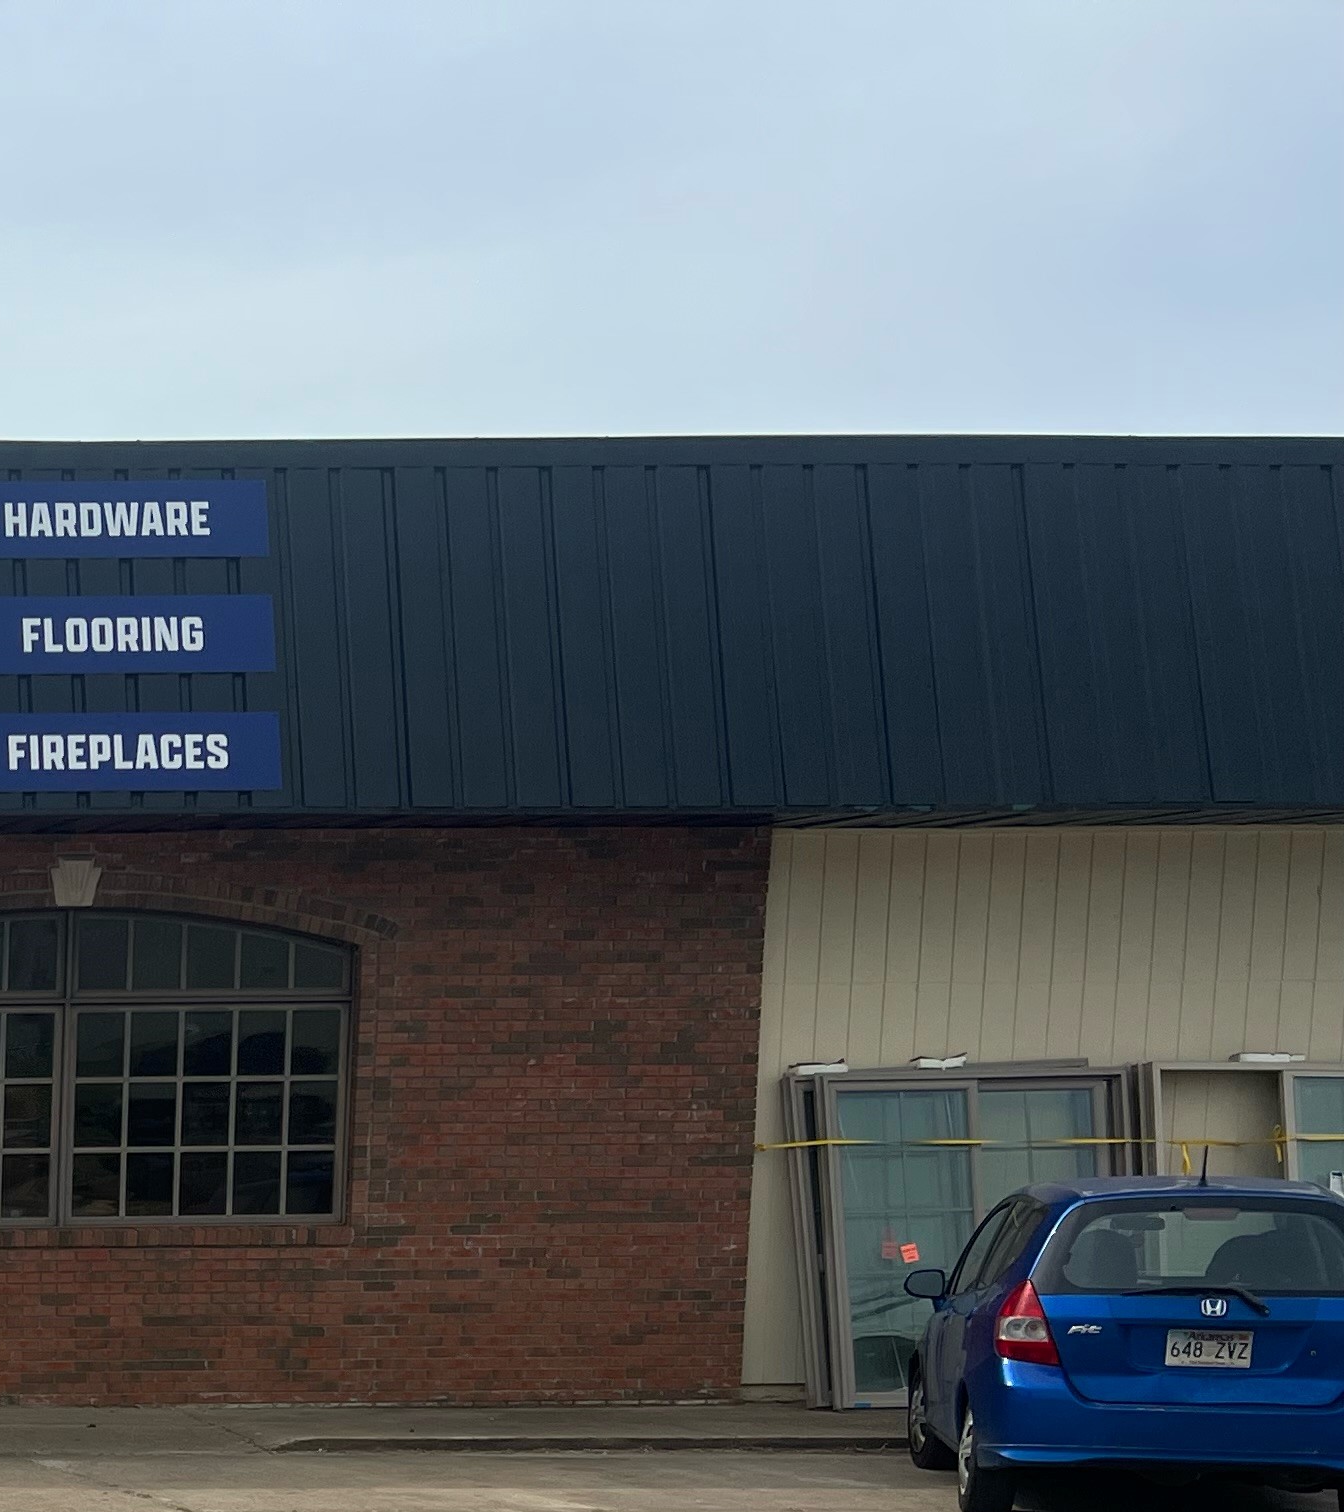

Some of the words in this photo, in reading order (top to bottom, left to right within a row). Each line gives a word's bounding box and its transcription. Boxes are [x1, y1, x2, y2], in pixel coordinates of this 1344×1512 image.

[4, 501, 211, 538] HARDWARE
[22, 616, 204, 653] FLOORING
[7, 733, 230, 771] FIREPLACES
[1170, 1341, 1203, 1358] 648
[1214, 1342, 1250, 1360] ZVZ
